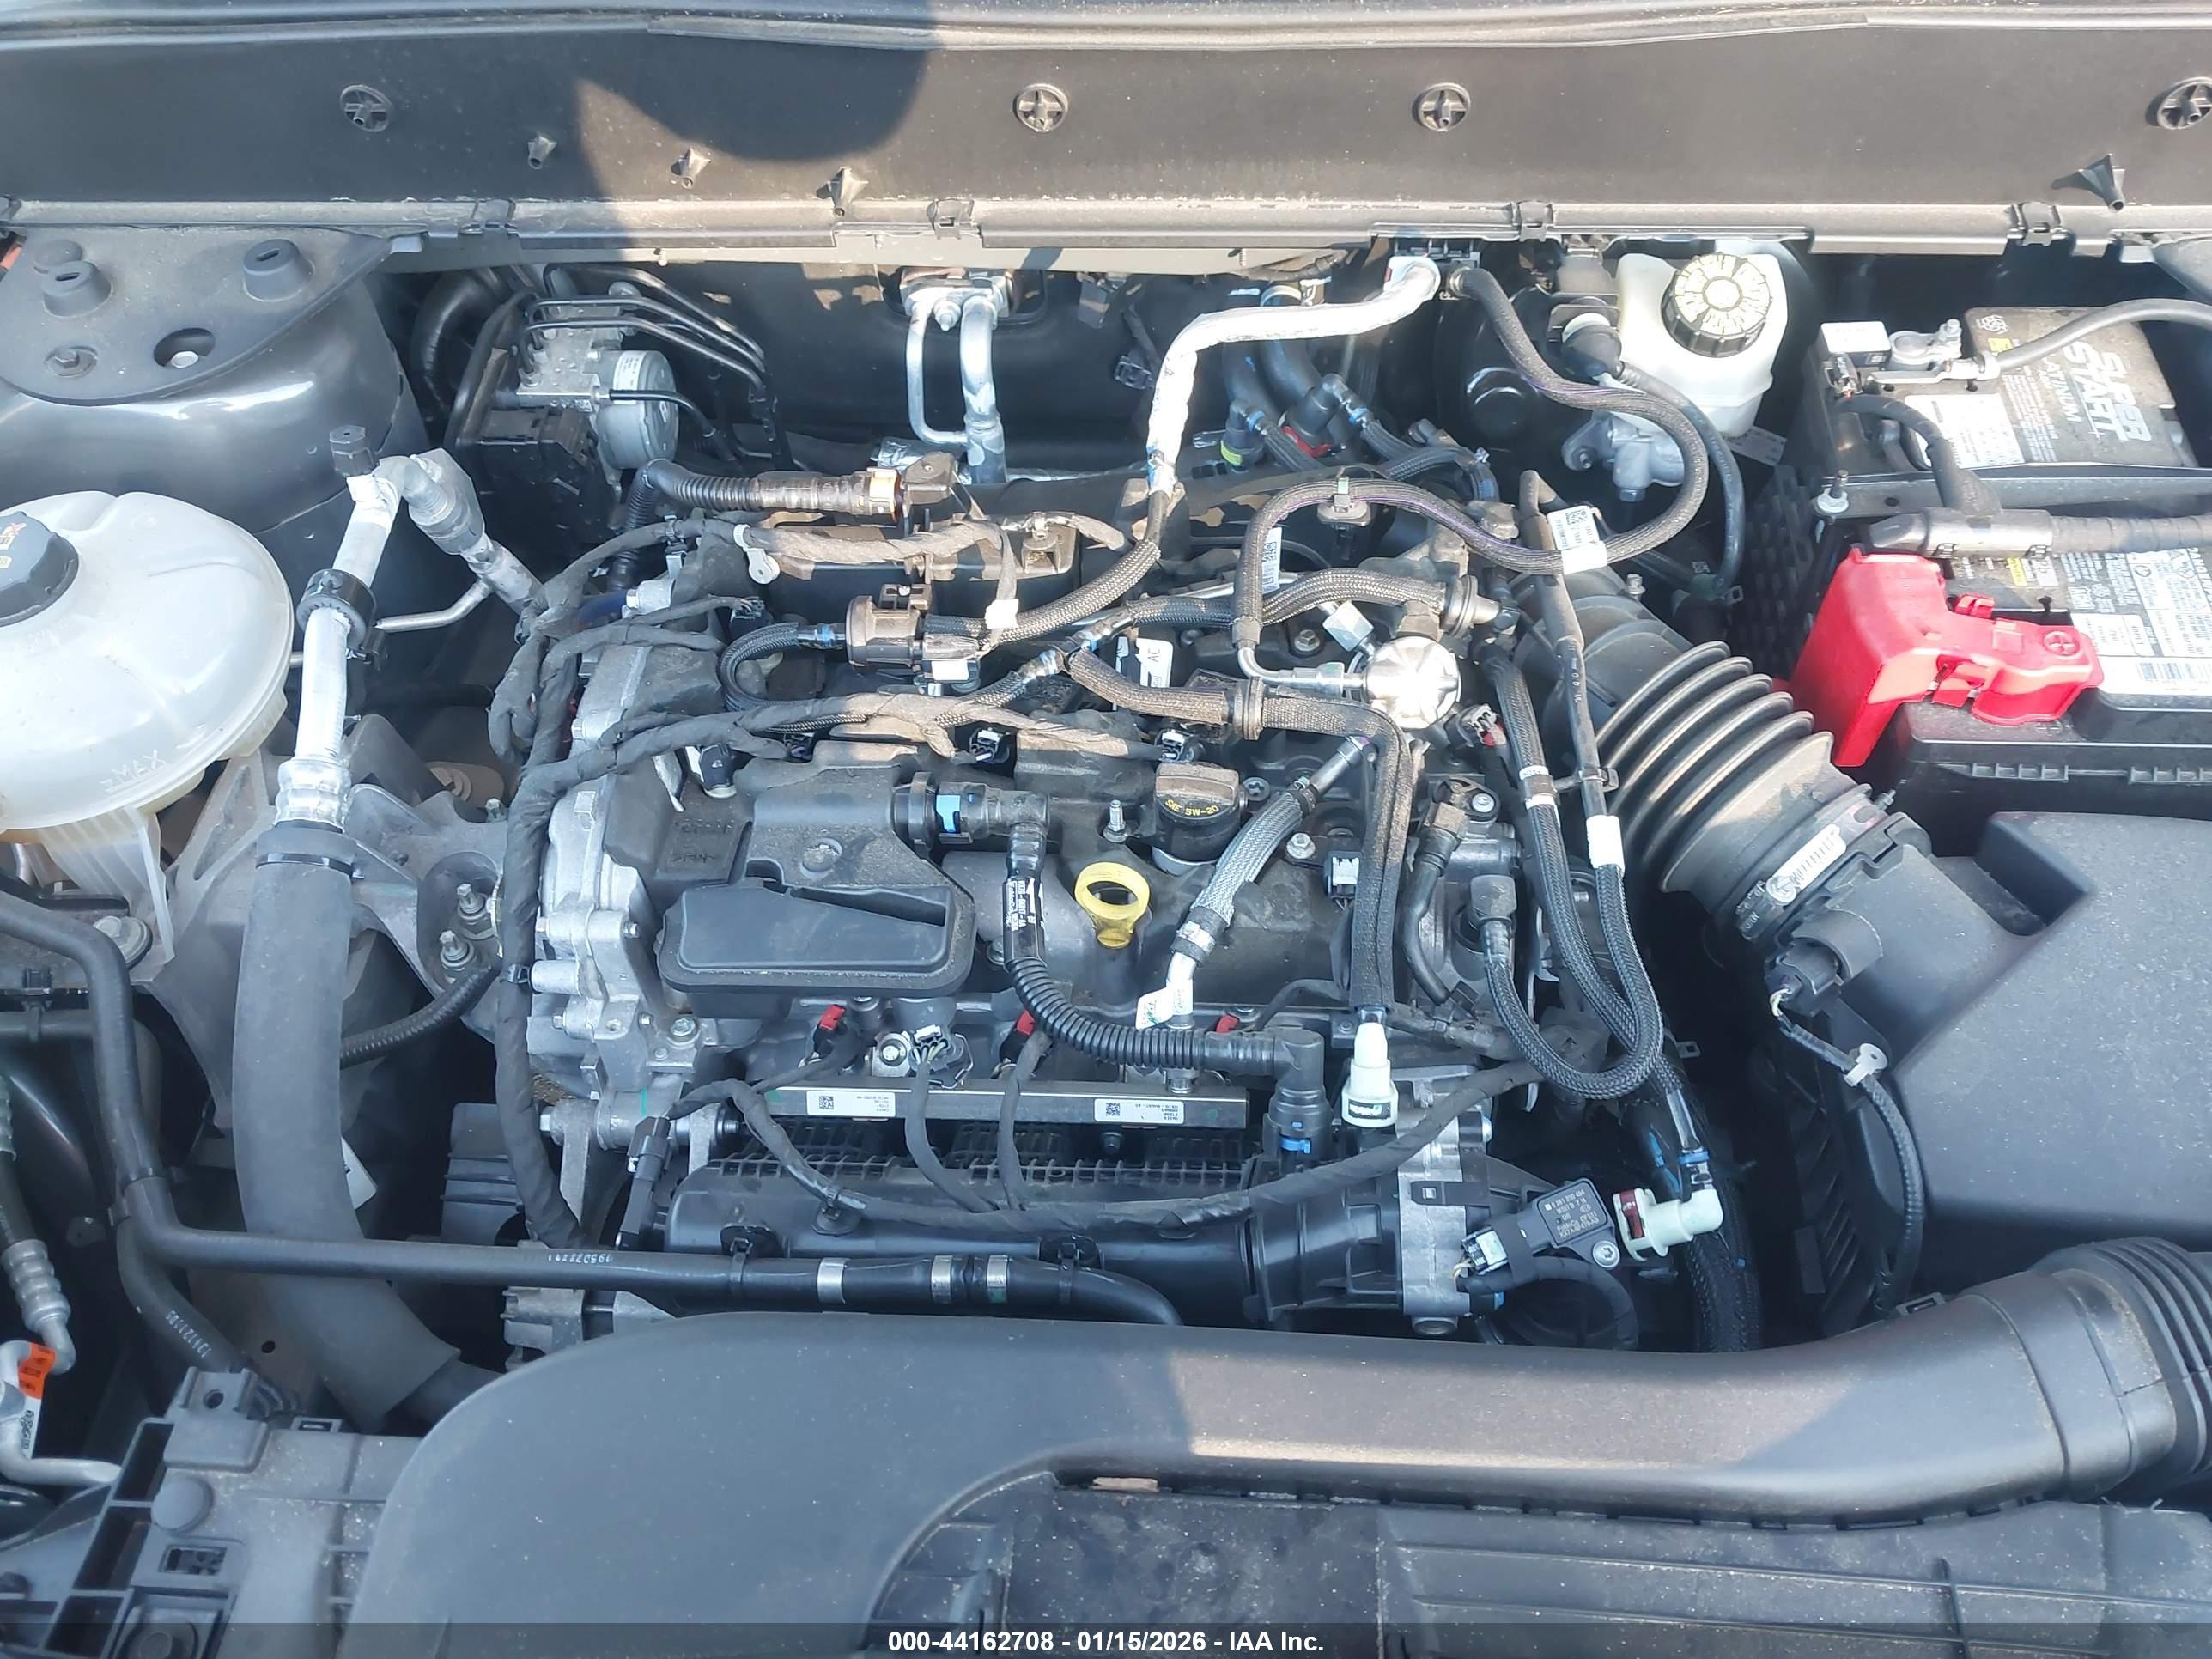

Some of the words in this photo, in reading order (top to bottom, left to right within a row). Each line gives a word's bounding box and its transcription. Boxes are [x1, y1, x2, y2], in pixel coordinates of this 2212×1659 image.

[2043, 355, 2082, 422] LATINUM
[2062, 341, 2129, 442] START
[2096, 351, 2151, 441] SUPER
[1165, 799, 1182, 812] SAE
[1185, 805, 1219, 816] 5W-20
